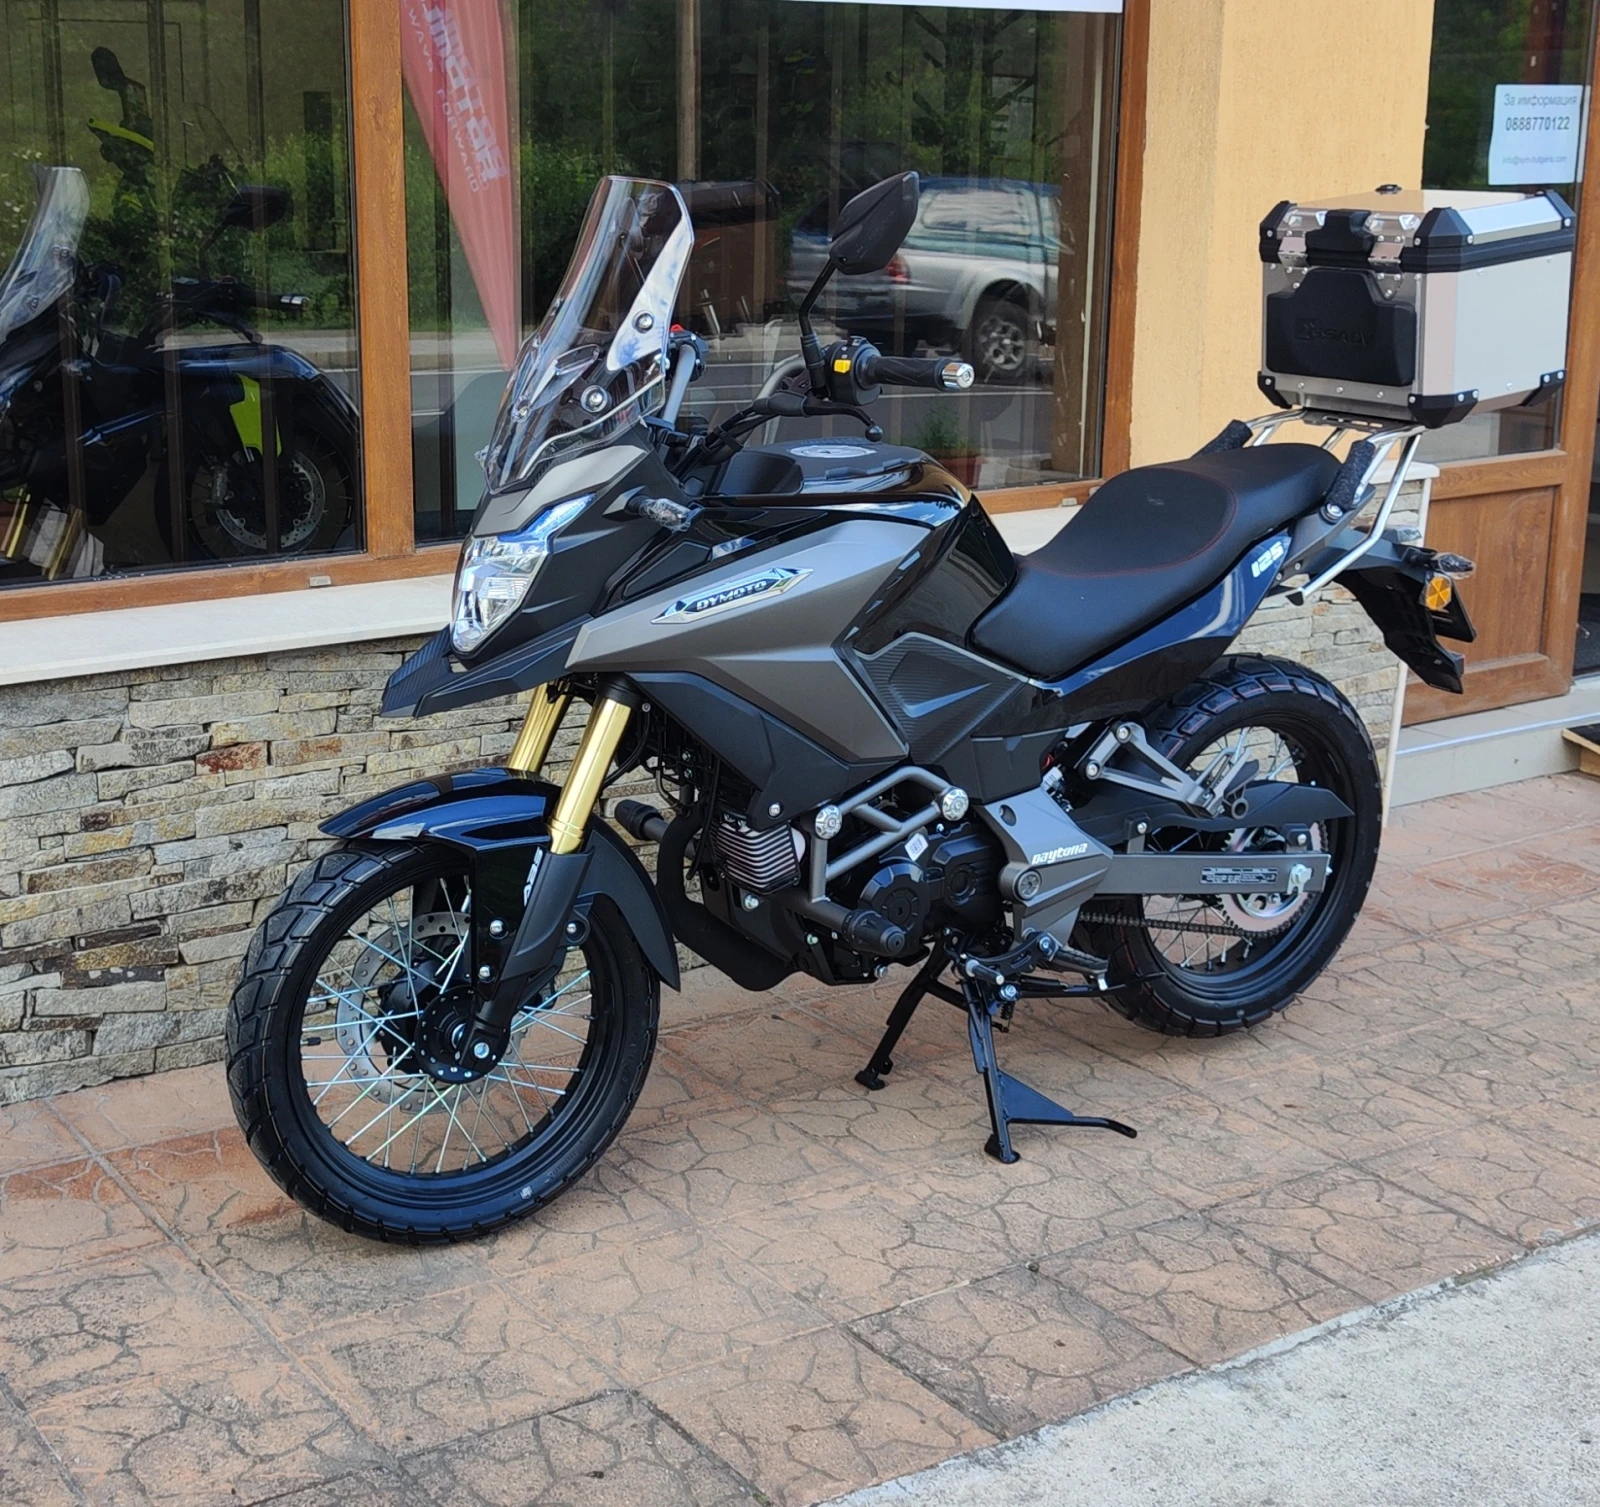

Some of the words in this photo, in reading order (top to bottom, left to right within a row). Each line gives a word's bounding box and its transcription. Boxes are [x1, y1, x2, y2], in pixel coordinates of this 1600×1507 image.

[422, 0, 498, 182] JMOTOR
[1504, 93, 1516, 106] За
[1505, 116, 1570, 131] 0888770122
[437, 89, 479, 192] FORWARD
[1251, 541, 1284, 578] 125
[696, 580, 767, 610] DYMOTO
